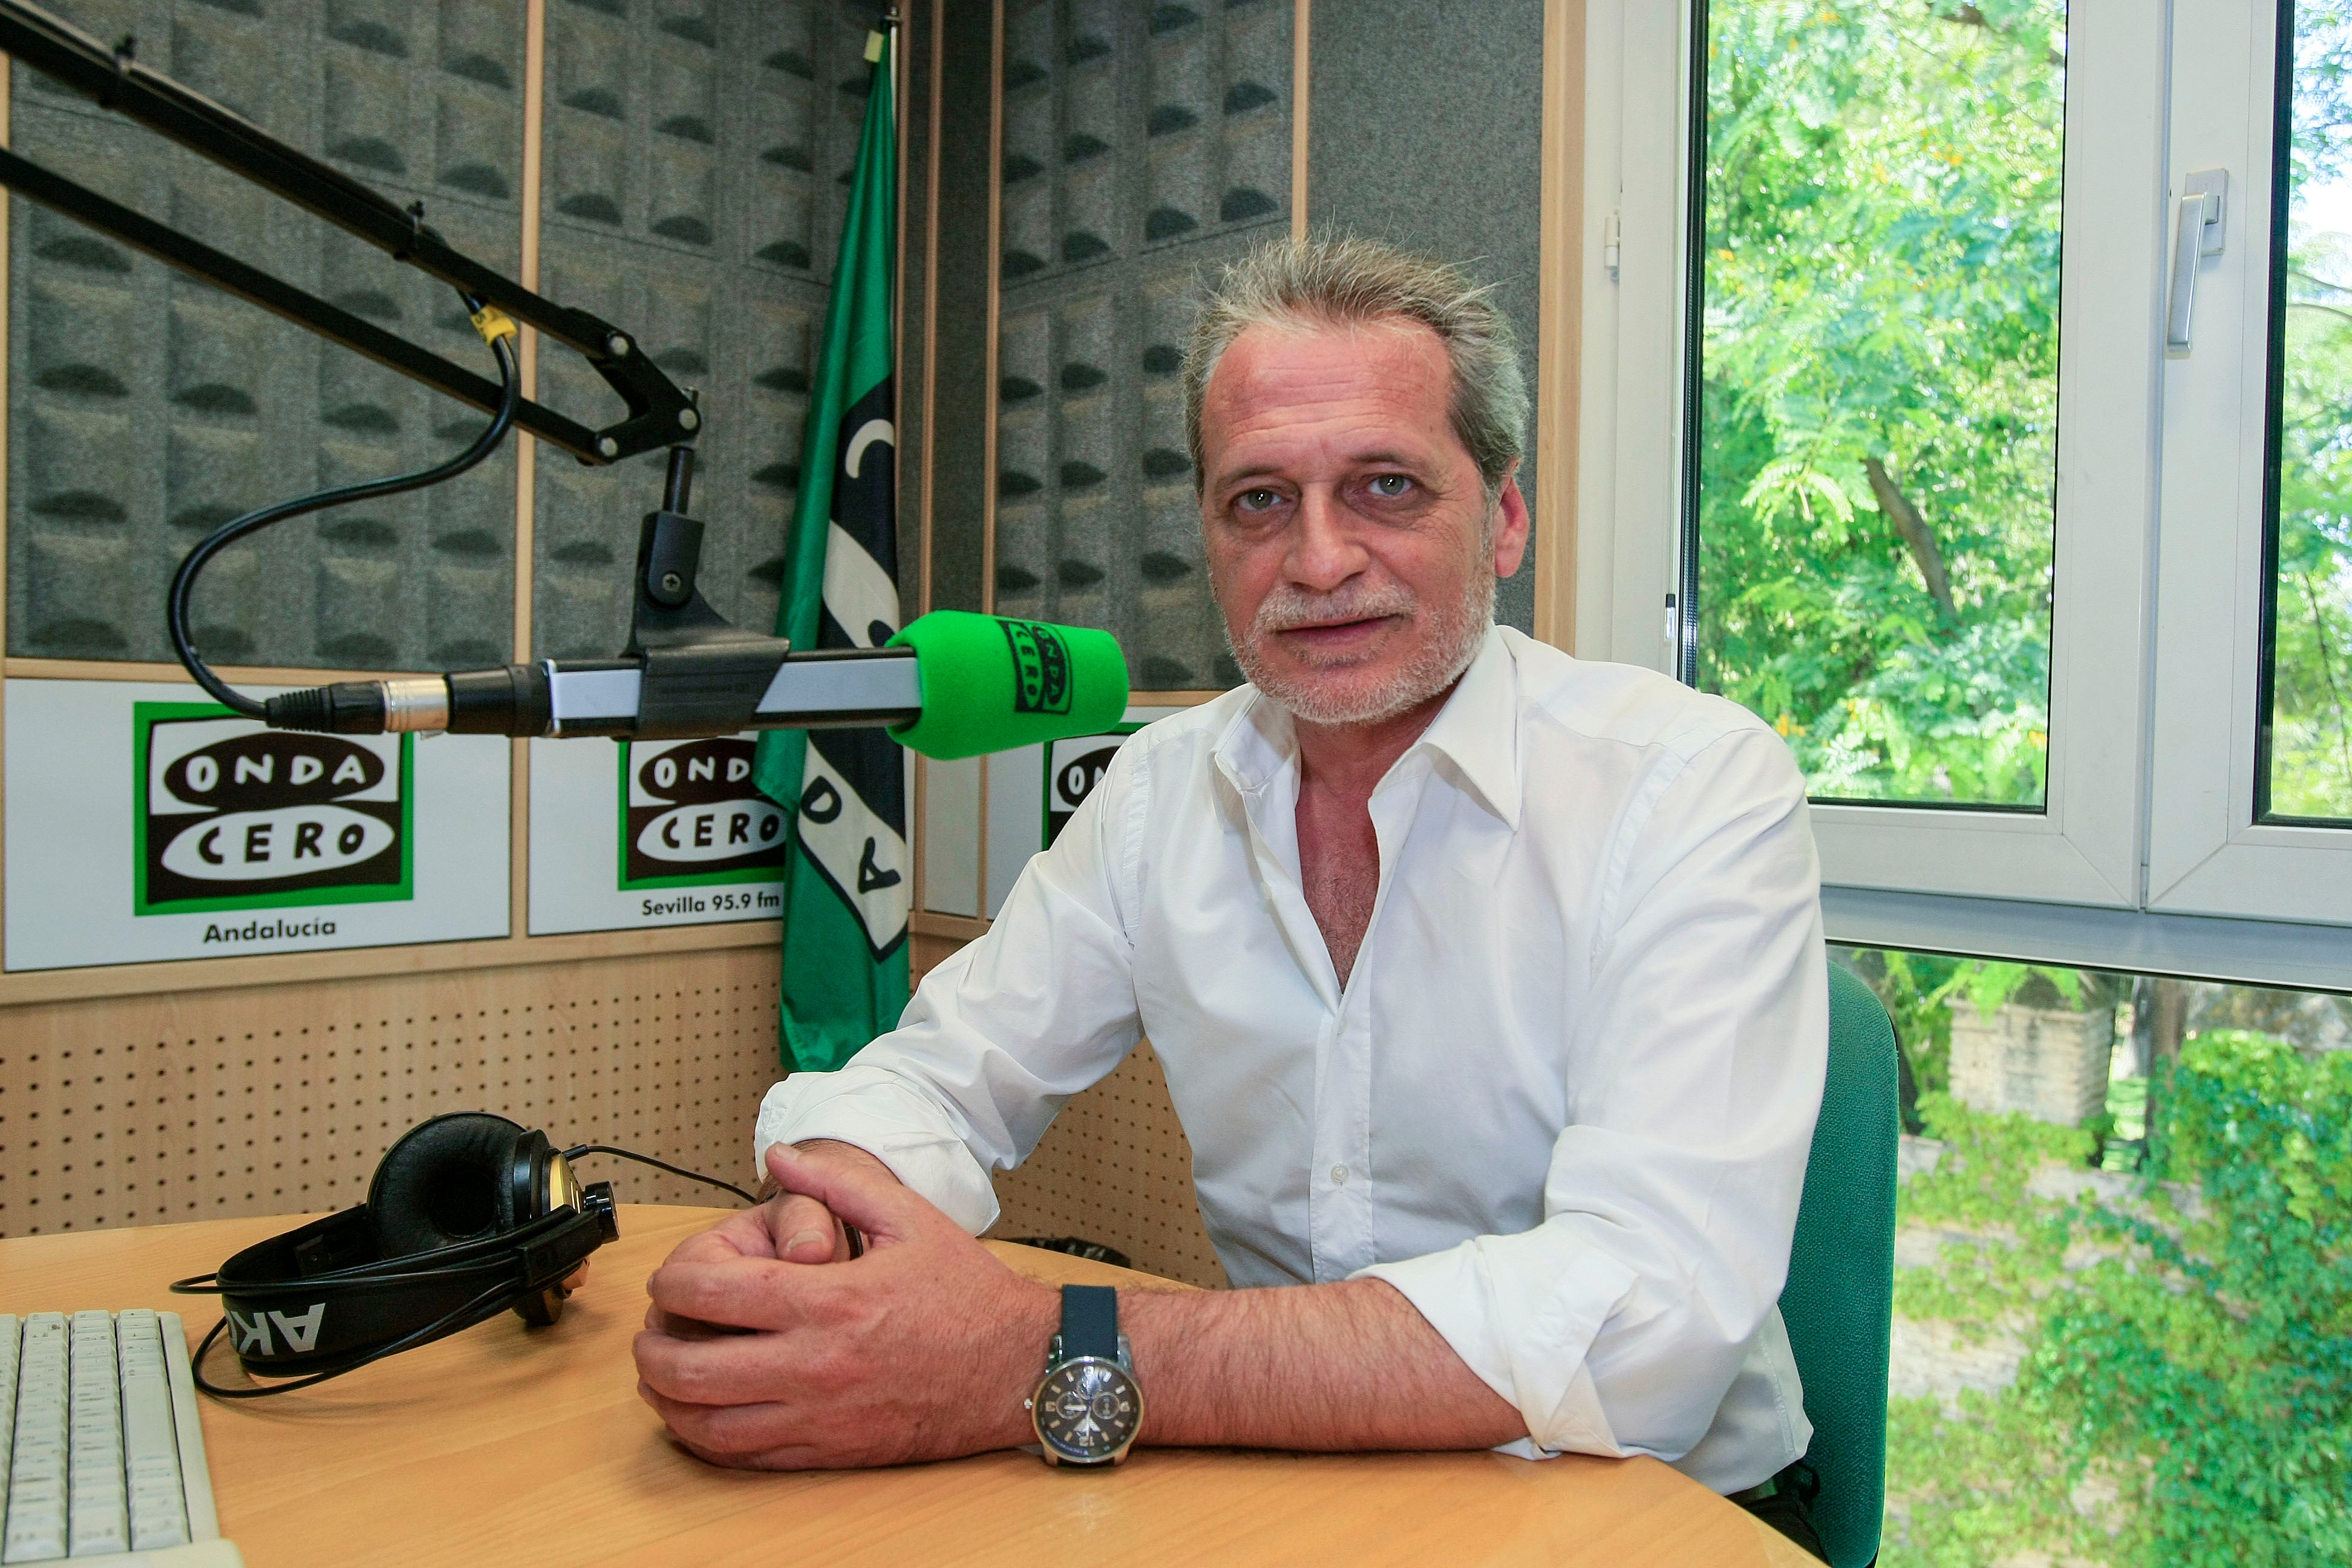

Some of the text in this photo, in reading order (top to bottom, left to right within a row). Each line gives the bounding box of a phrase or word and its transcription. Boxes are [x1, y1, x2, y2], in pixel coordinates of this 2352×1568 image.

[1016, 630, 1039, 696] CERO
[1038, 627, 1059, 696] ONDA
[185, 753, 367, 792] ONDA
[653, 756, 750, 789] OND
[197, 822, 365, 865] CERO
[662, 812, 780, 849] CERO
[642, 892, 780, 916] Sevilla 95.9 fm
[203, 916, 336, 944] Andalucía
